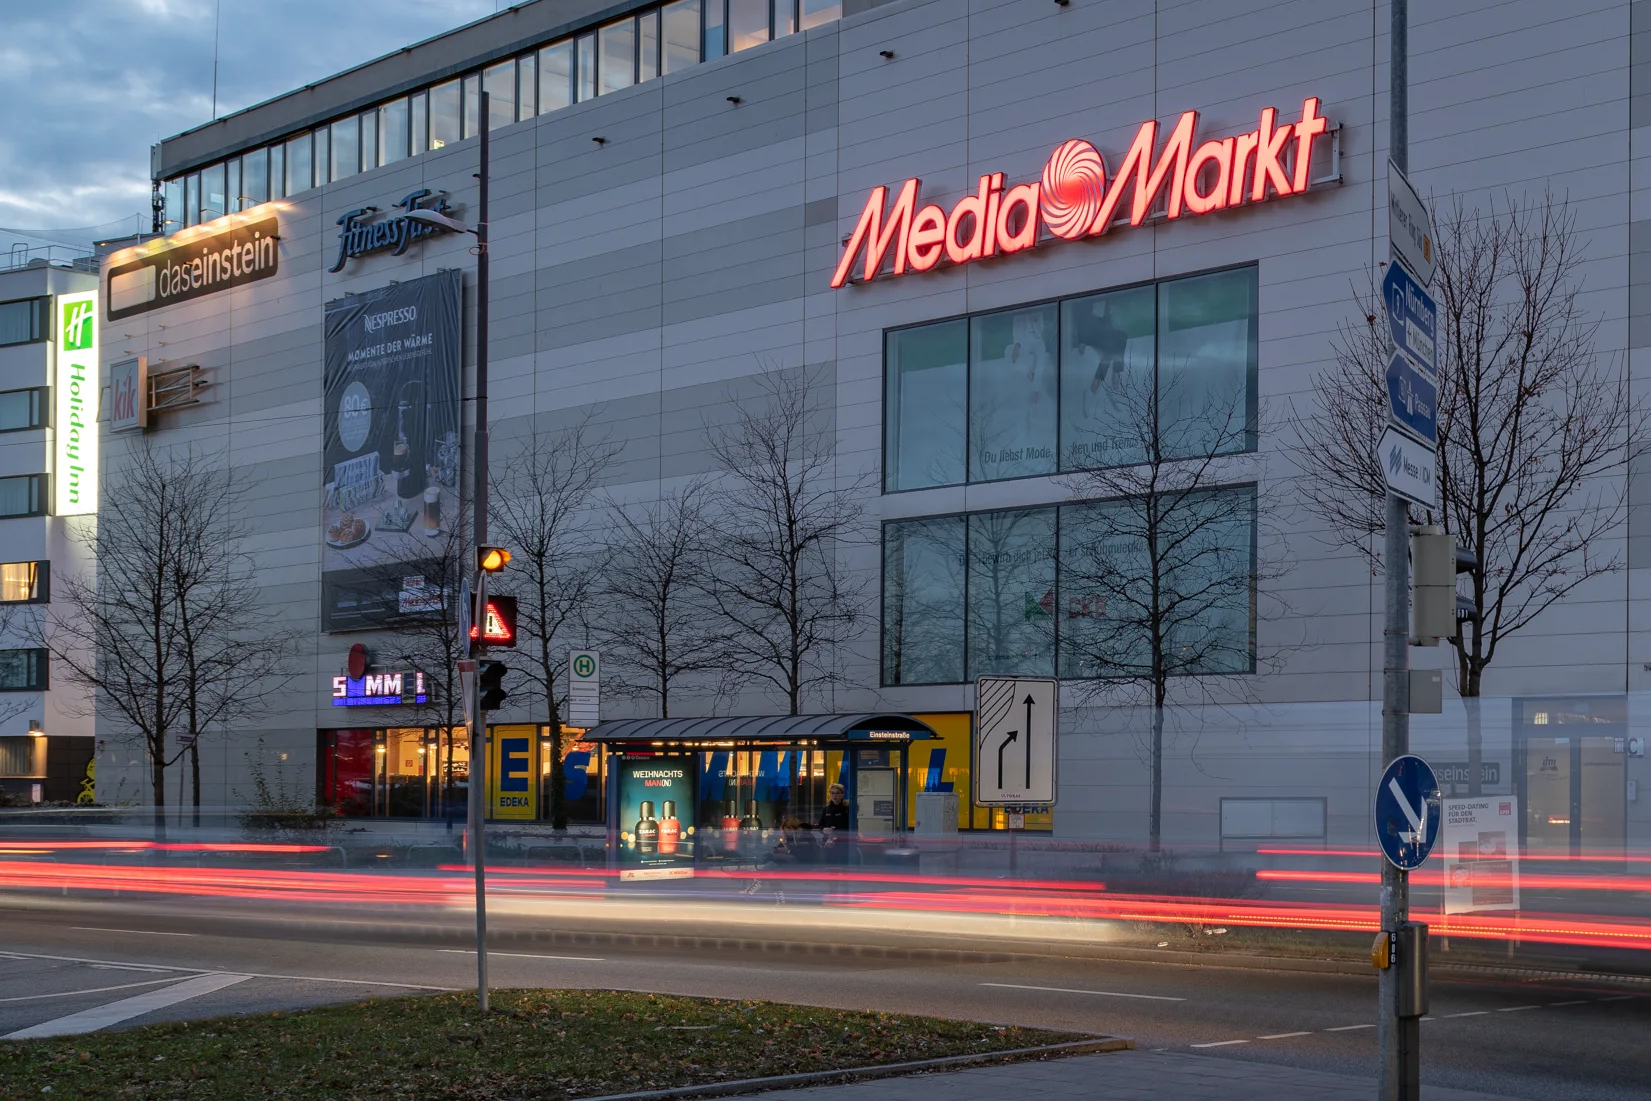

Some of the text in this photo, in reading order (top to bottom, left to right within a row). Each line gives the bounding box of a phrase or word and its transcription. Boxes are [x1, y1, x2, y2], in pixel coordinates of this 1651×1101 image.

[159, 231, 273, 297] daseinstein
[363, 305, 417, 333] NESPRESSO
[348, 333, 433, 362] MOMENTE DER WÄRME
[69, 363, 86, 504] Holiday Inn
[984, 451, 996, 464] Du
[1403, 455, 1418, 480] Messe
[869, 730, 910, 739] Einsteinstraße
[632, 770, 684, 779] WEIHNACHTS
[644, 779, 672, 787] MAN(N)
[500, 796, 529, 808] EDEKA
[1448, 803, 1489, 811] SPEED-DATING
[1448, 810, 1459, 818] FÜR
